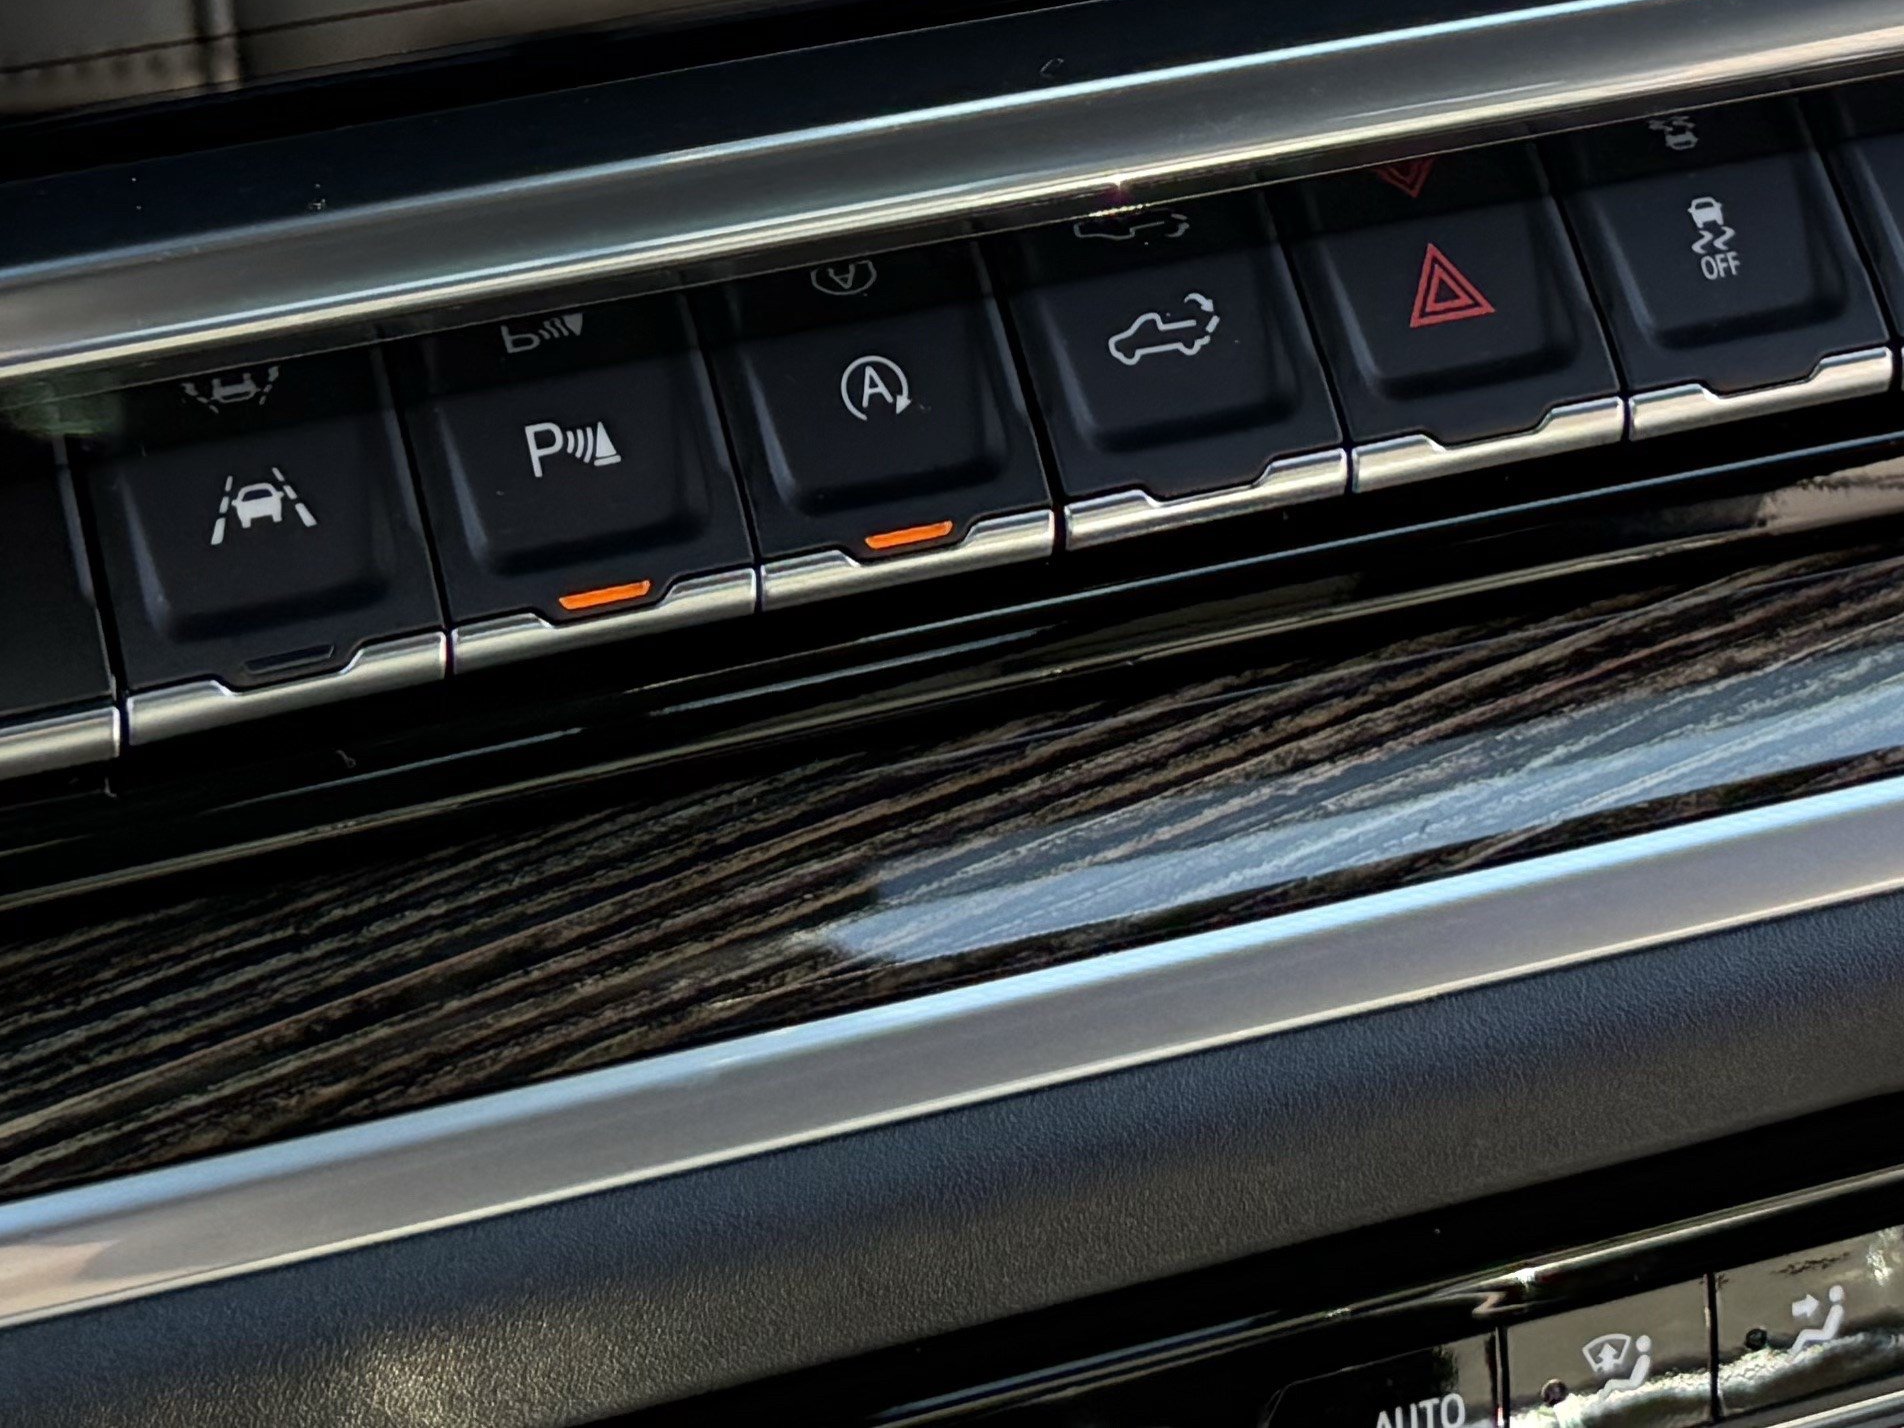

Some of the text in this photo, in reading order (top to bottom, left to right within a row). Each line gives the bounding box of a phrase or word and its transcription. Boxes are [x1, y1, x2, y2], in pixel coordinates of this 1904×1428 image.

[1700, 250, 1741, 281] OFF
[861, 365, 894, 409] A
[524, 420, 565, 479] P
[1375, 1392, 1466, 1428] AUTO
